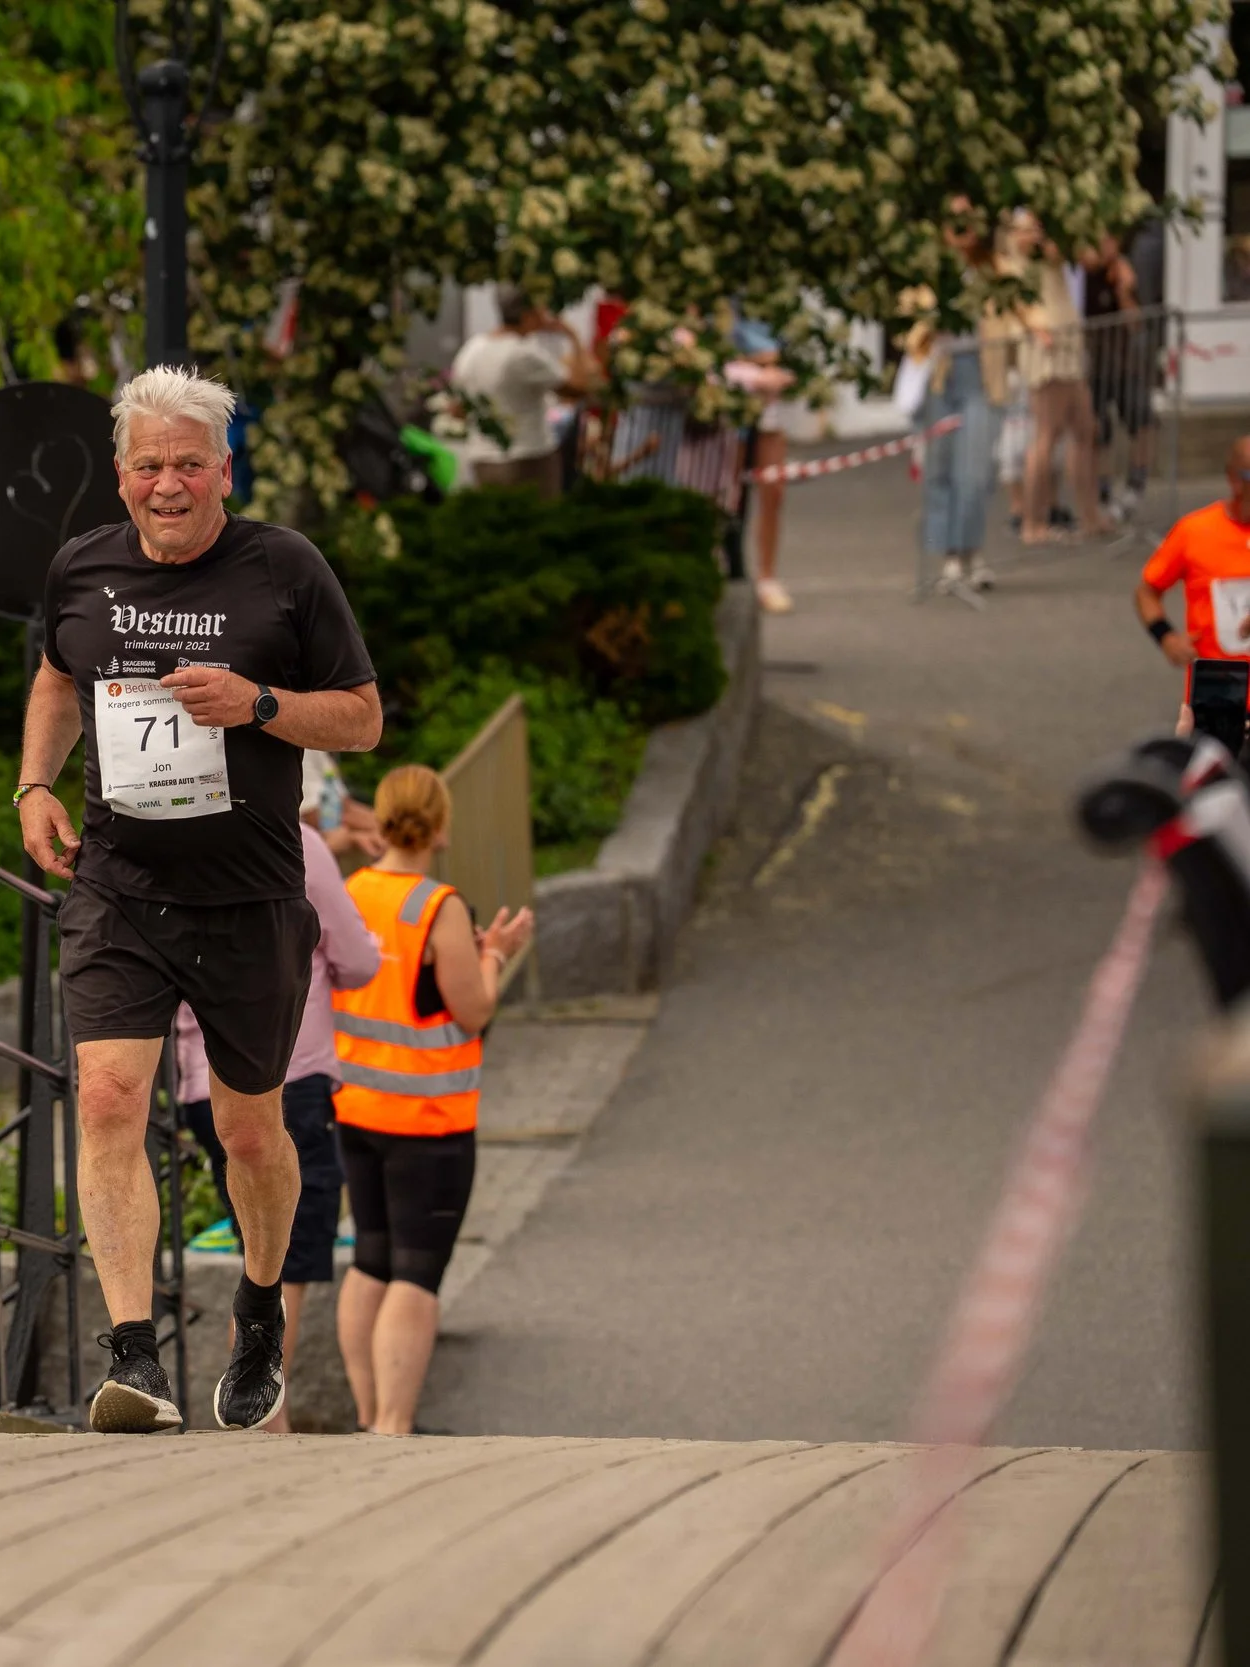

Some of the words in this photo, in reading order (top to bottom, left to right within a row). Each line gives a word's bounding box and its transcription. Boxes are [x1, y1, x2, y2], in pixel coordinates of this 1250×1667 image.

[109, 604, 227, 637] Vestmar
[124, 640, 183, 650] trimkarusell
[185, 641, 210, 651] 2021
[107, 701, 141, 709] Kragerø
[134, 714, 180, 752] 71
[152, 763, 172, 773] Jon
[178, 777, 195, 786] AUTO
[137, 800, 162, 809] SWML
